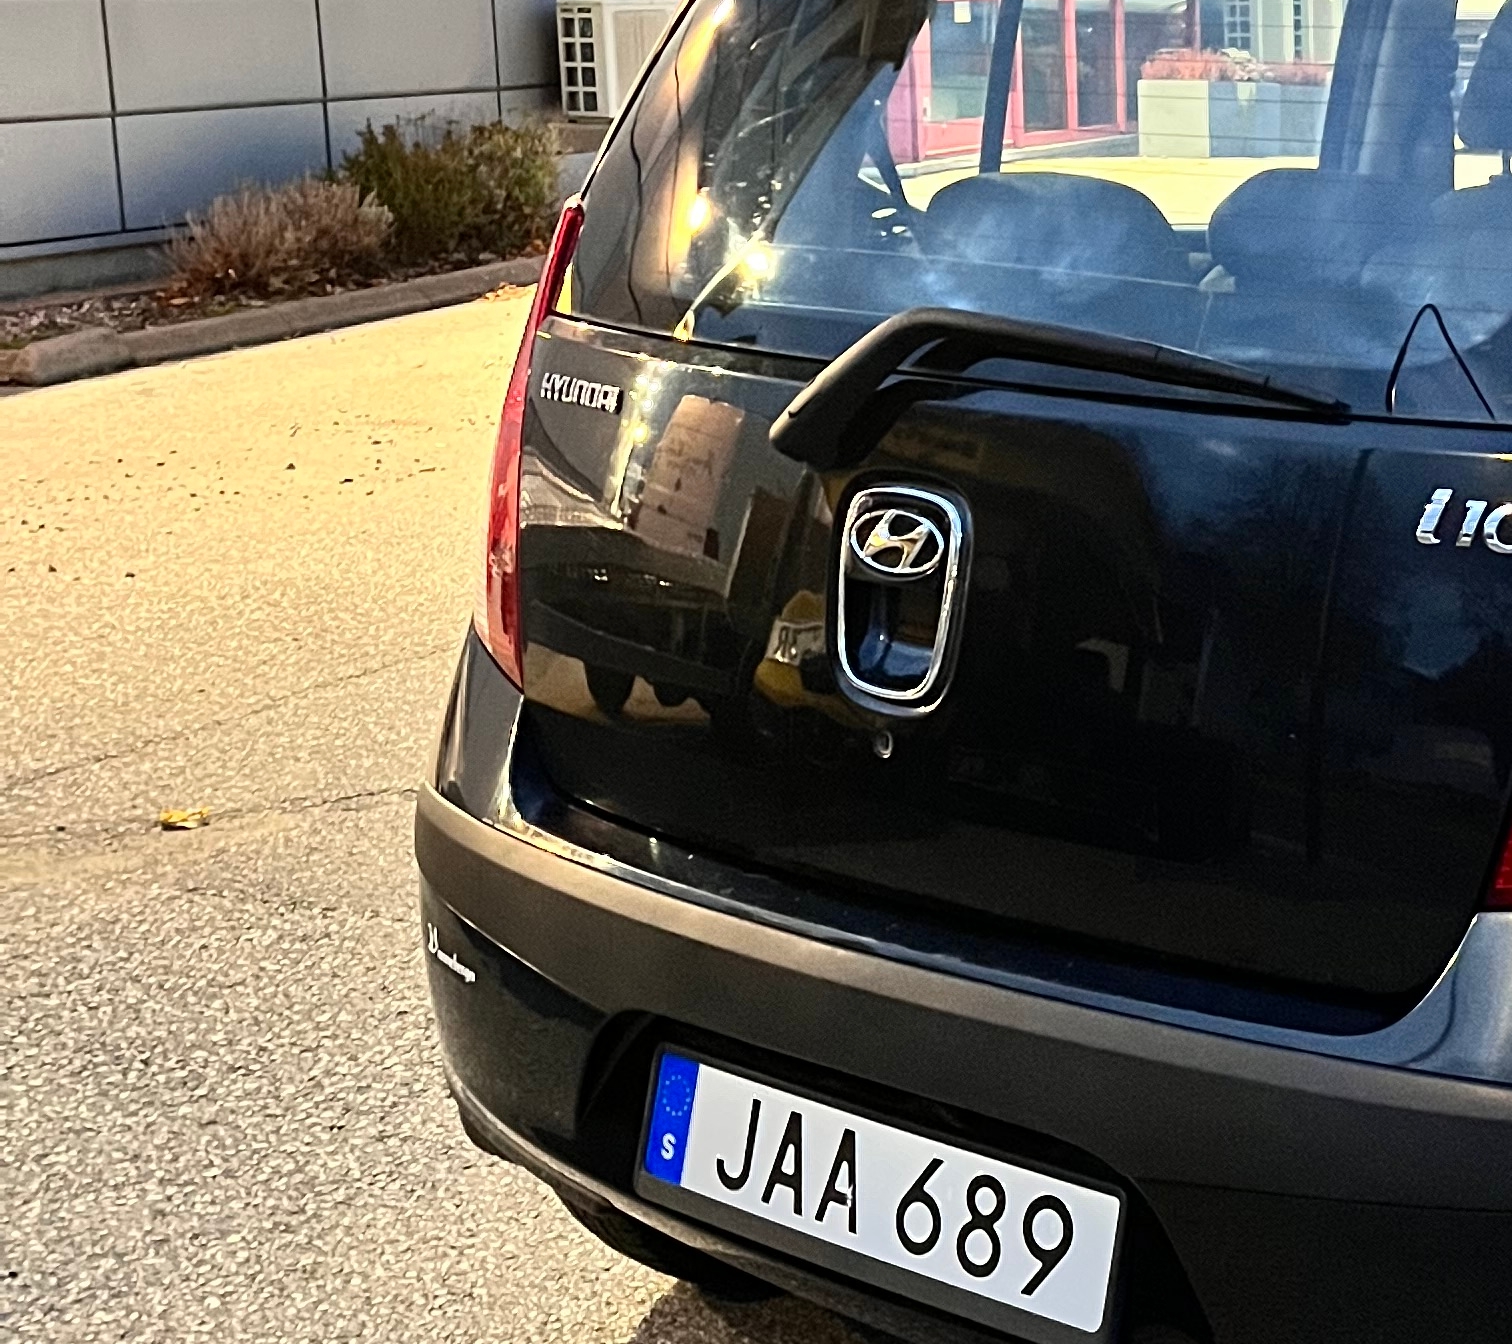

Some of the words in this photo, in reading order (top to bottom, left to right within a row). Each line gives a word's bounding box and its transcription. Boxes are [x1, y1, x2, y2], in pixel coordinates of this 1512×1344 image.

[540, 372, 620, 414] HYUNDAI
[660, 1132, 677, 1161] S
[716, 1098, 858, 1235] JAA
[895, 1158, 1074, 1298] 689
